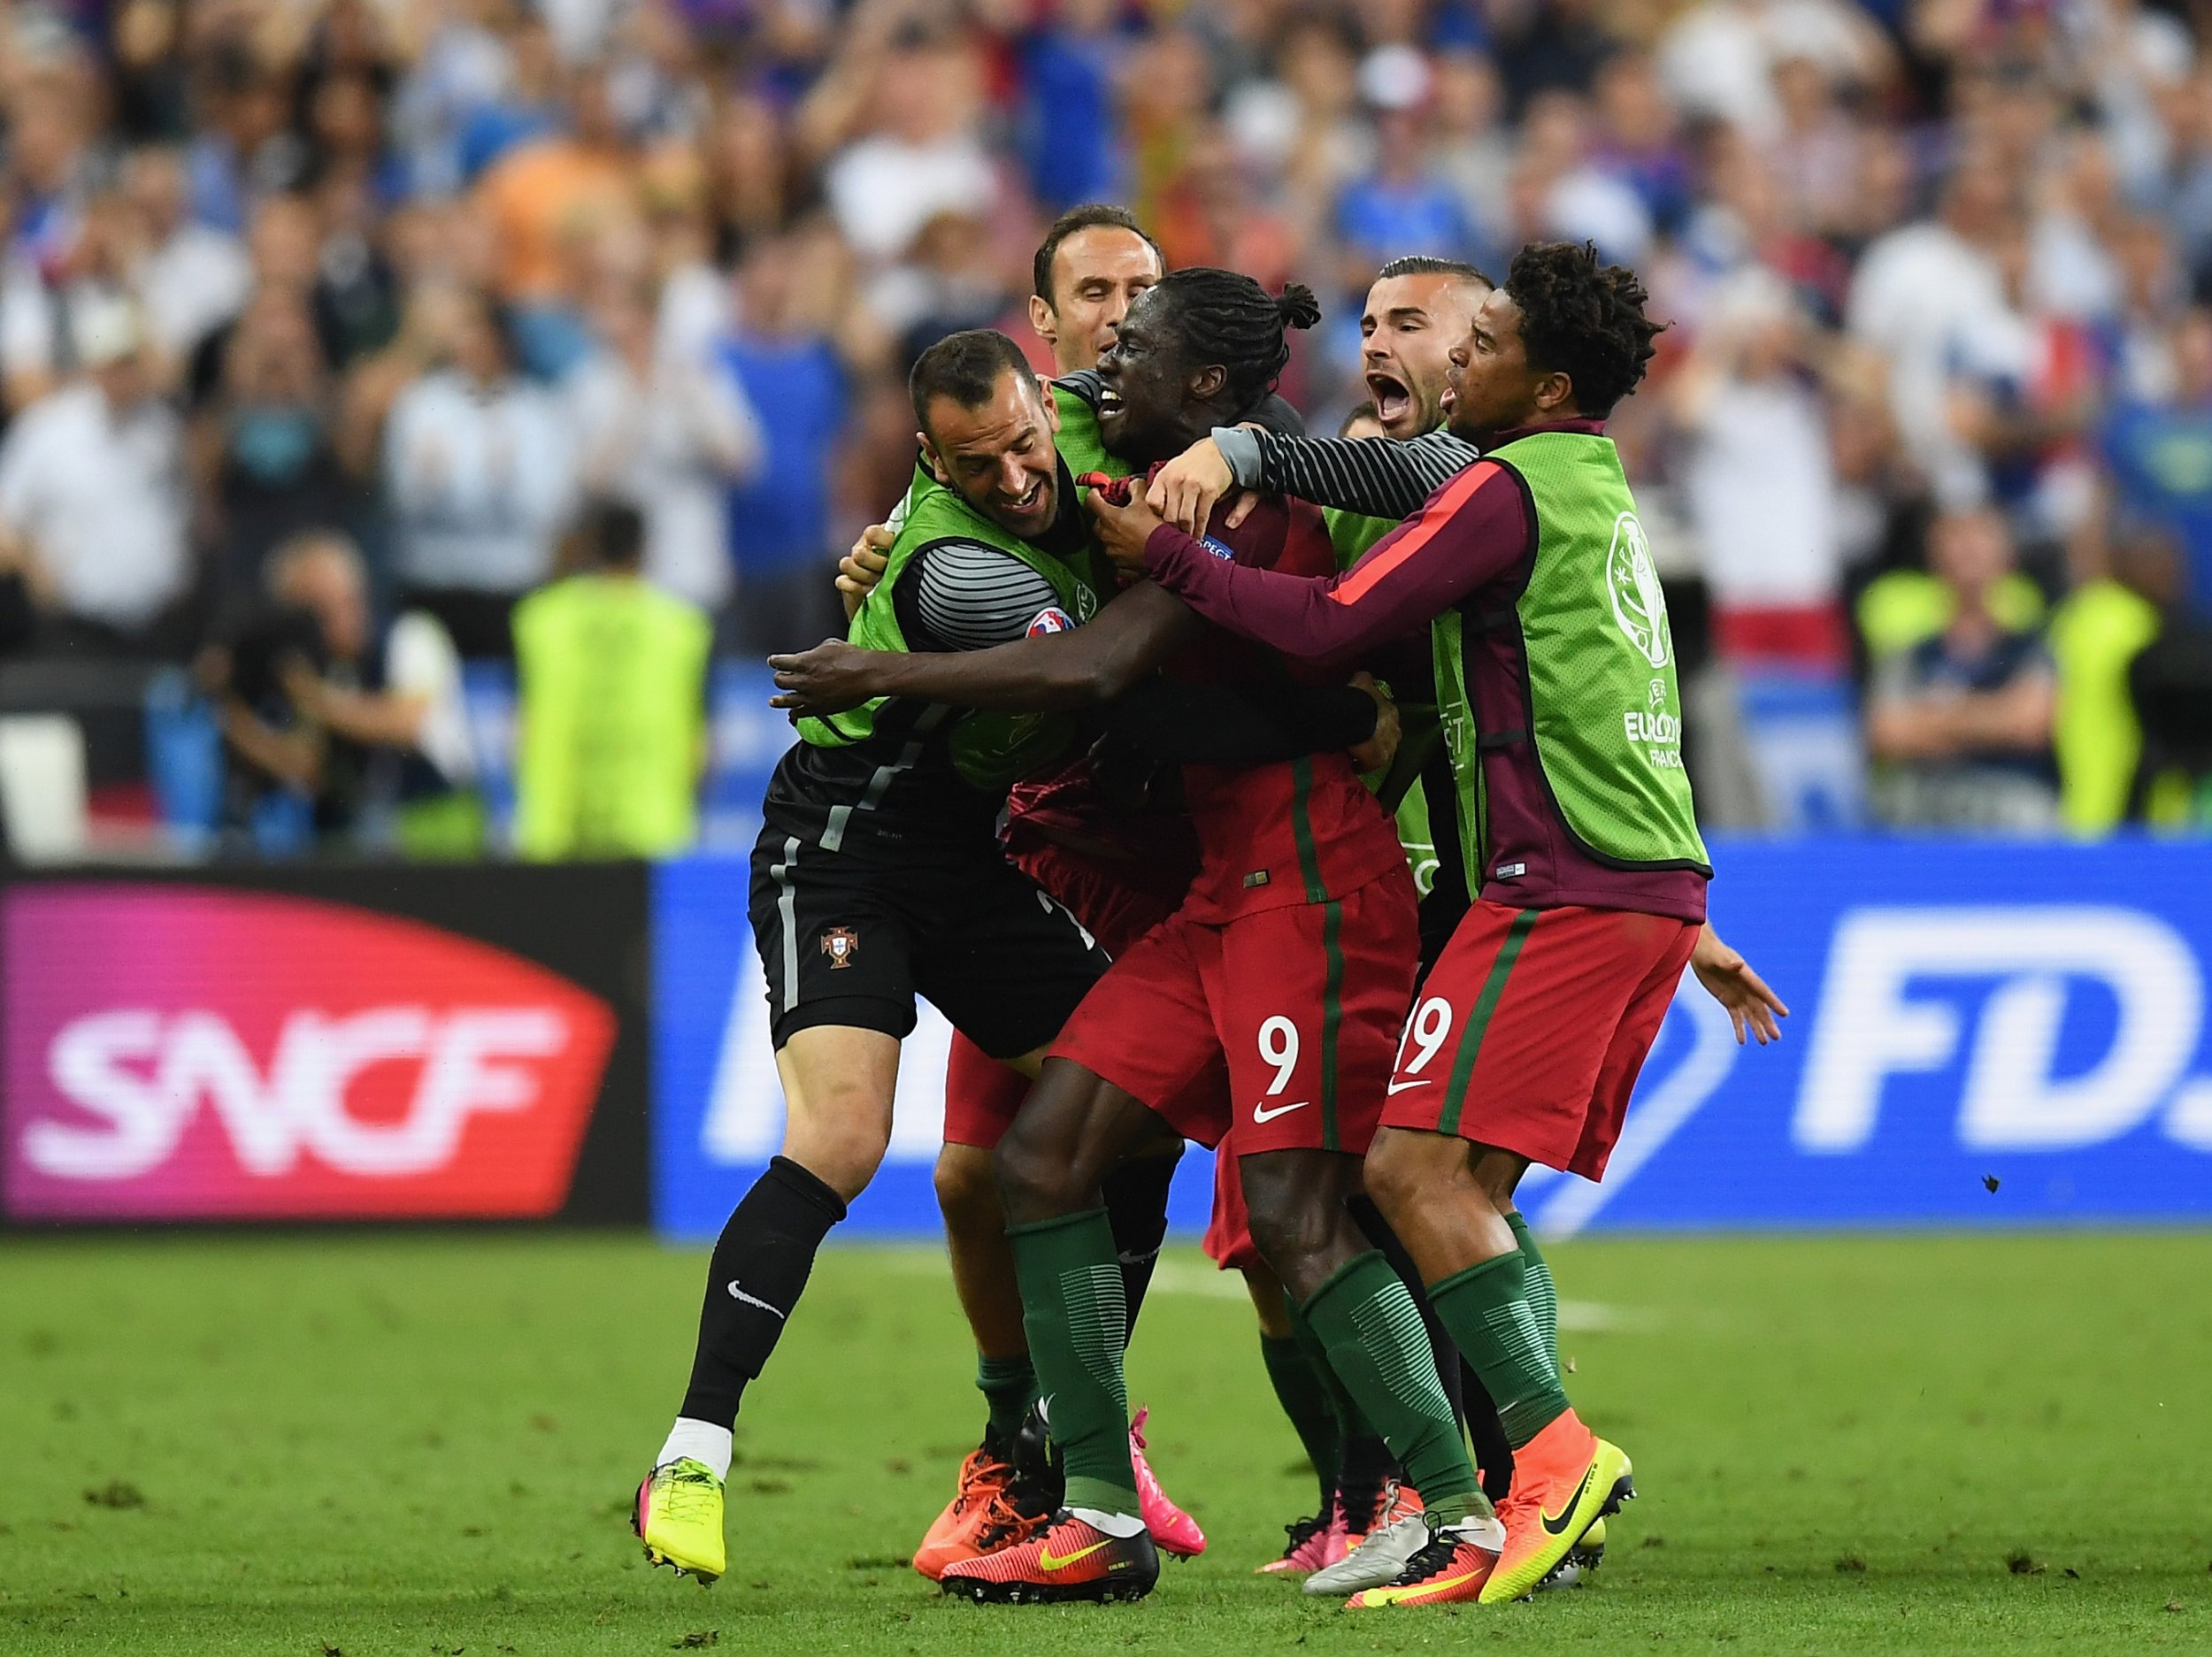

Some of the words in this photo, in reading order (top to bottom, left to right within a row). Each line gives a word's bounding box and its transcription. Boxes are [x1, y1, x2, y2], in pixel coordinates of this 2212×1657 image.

[23, 1009, 569, 1178] SNCF
[1257, 1015, 1300, 1095] 9
[1789, 904, 2212, 1153] FD
